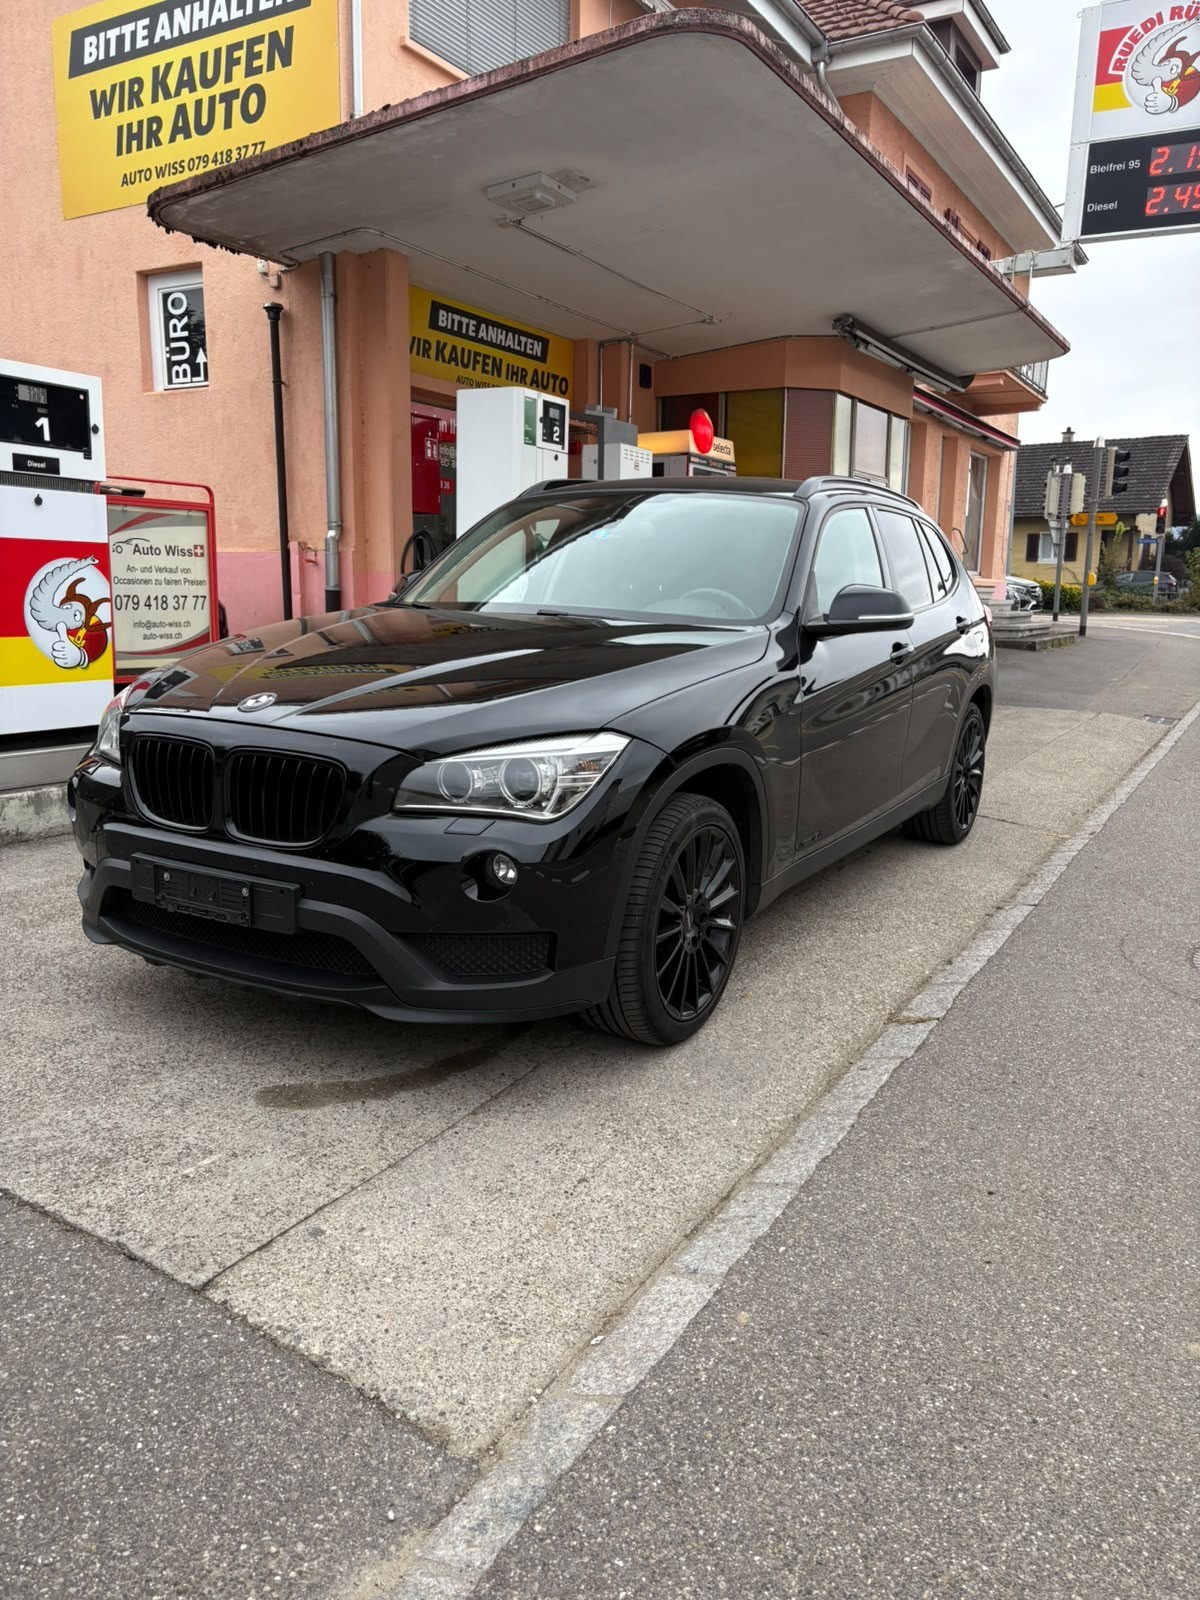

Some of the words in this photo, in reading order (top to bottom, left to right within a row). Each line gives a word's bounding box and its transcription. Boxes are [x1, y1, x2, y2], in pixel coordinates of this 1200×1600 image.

[83, 17, 150, 65] BITTE
[1112, 11, 1164, 71] RUEDI
[90, 76, 144, 120] WIR
[150, 25, 294, 105] KAUFEN
[115, 116, 163, 157] IHR
[169, 83, 267, 143] AUTO
[120, 167, 152, 188] AUTO
[155, 160, 185, 179] WISS
[187, 154, 210, 172] 079
[211, 148, 233, 167] 418
[235, 144, 250, 161] 37
[1090, 161, 1126, 174] Bleifrei
[1128, 159, 1141, 170] 95
[1149, 145, 1200, 175] 2.1
[1087, 200, 1118, 213] Diesel
[165, 292, 191, 384] BÜRO
[438, 309, 477, 337] BITTE
[478, 323, 542, 357] ANHALTEN
[434, 340, 503, 378] KAUFEN
[505, 363, 528, 385] IHR
[530, 369, 569, 396] AUTO
[456, 375, 474, 387] AUTO
[35, 416, 51, 442] 1
[553, 426, 560, 442] 2
[713, 443, 731, 456] selecta
[27, 460, 46, 469] Diesel
[132, 543, 161, 556] Auto
[164, 545, 193, 557] Wiss
[126, 564, 139, 573] An-
[140, 565, 152, 573] und
[154, 565, 179, 574] Verkauf
[113, 576, 154, 585] Occasionen
[164, 577, 182, 586] fairen
[183, 578, 207, 586] Preisen
[114, 594, 140, 611] 079
[144, 594, 168, 611] 418
[172, 595, 188, 611] 37
[192, 595, 207, 611] 77
[133, 620, 191, 630] info@auto-wiss.ch
[142, 632, 182, 640] auto-wiss.ch
